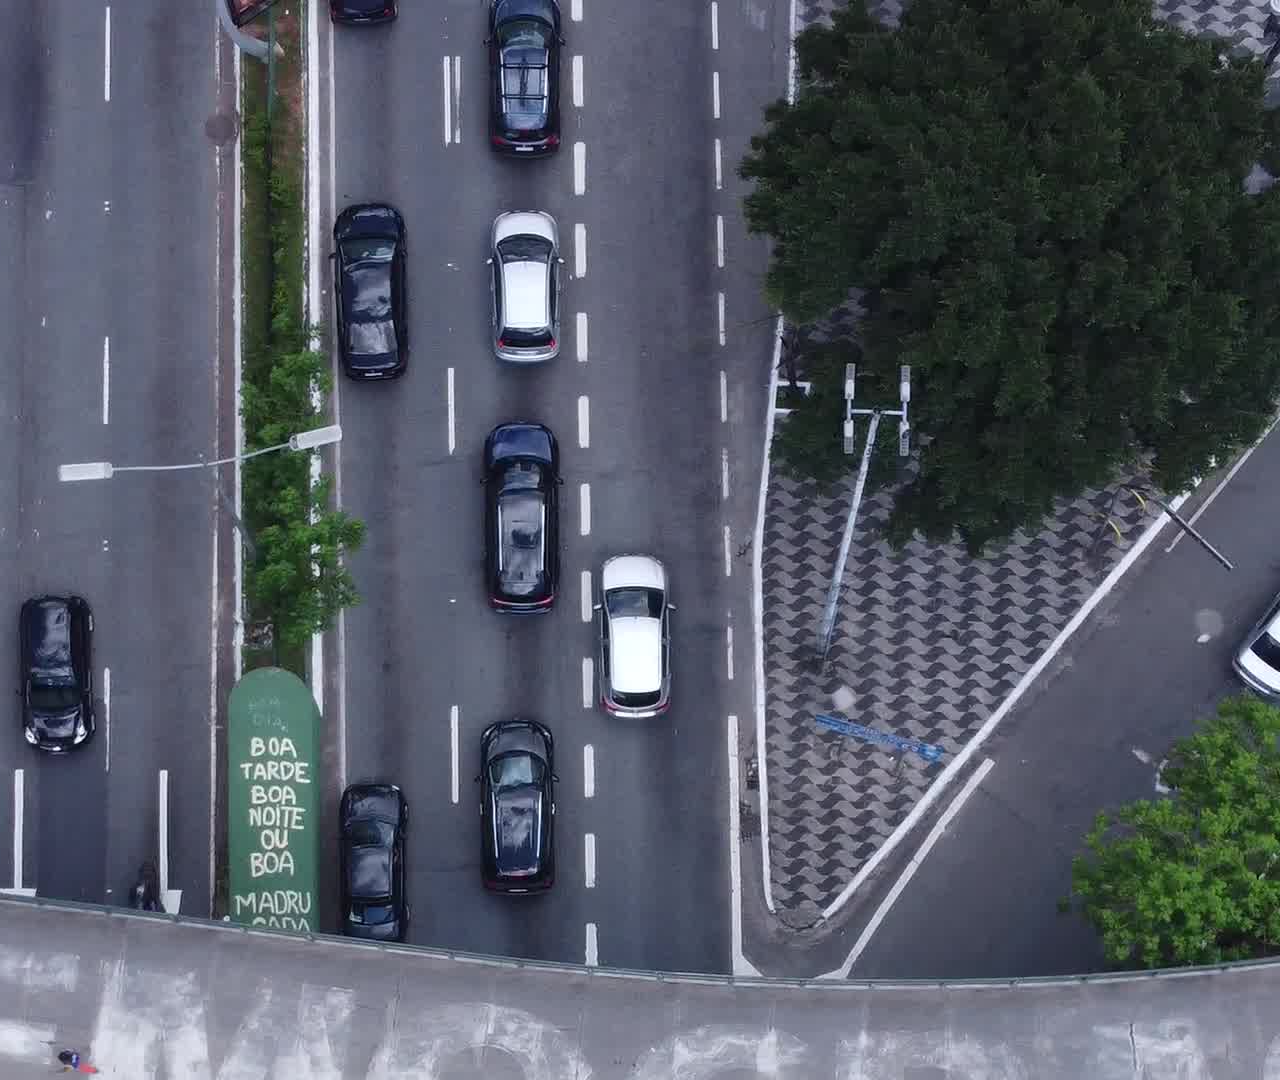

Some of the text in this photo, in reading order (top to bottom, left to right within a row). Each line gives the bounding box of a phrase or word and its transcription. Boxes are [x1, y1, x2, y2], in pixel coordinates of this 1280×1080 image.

[250, 737, 297, 757] BOA
[239, 761, 312, 784] TARDE
[251, 785, 297, 805] BOA
[248, 804, 306, 830] NOITE
[260, 828, 289, 850] OU
[250, 851, 295, 878] BOA
[235, 889, 312, 916] MADRU
